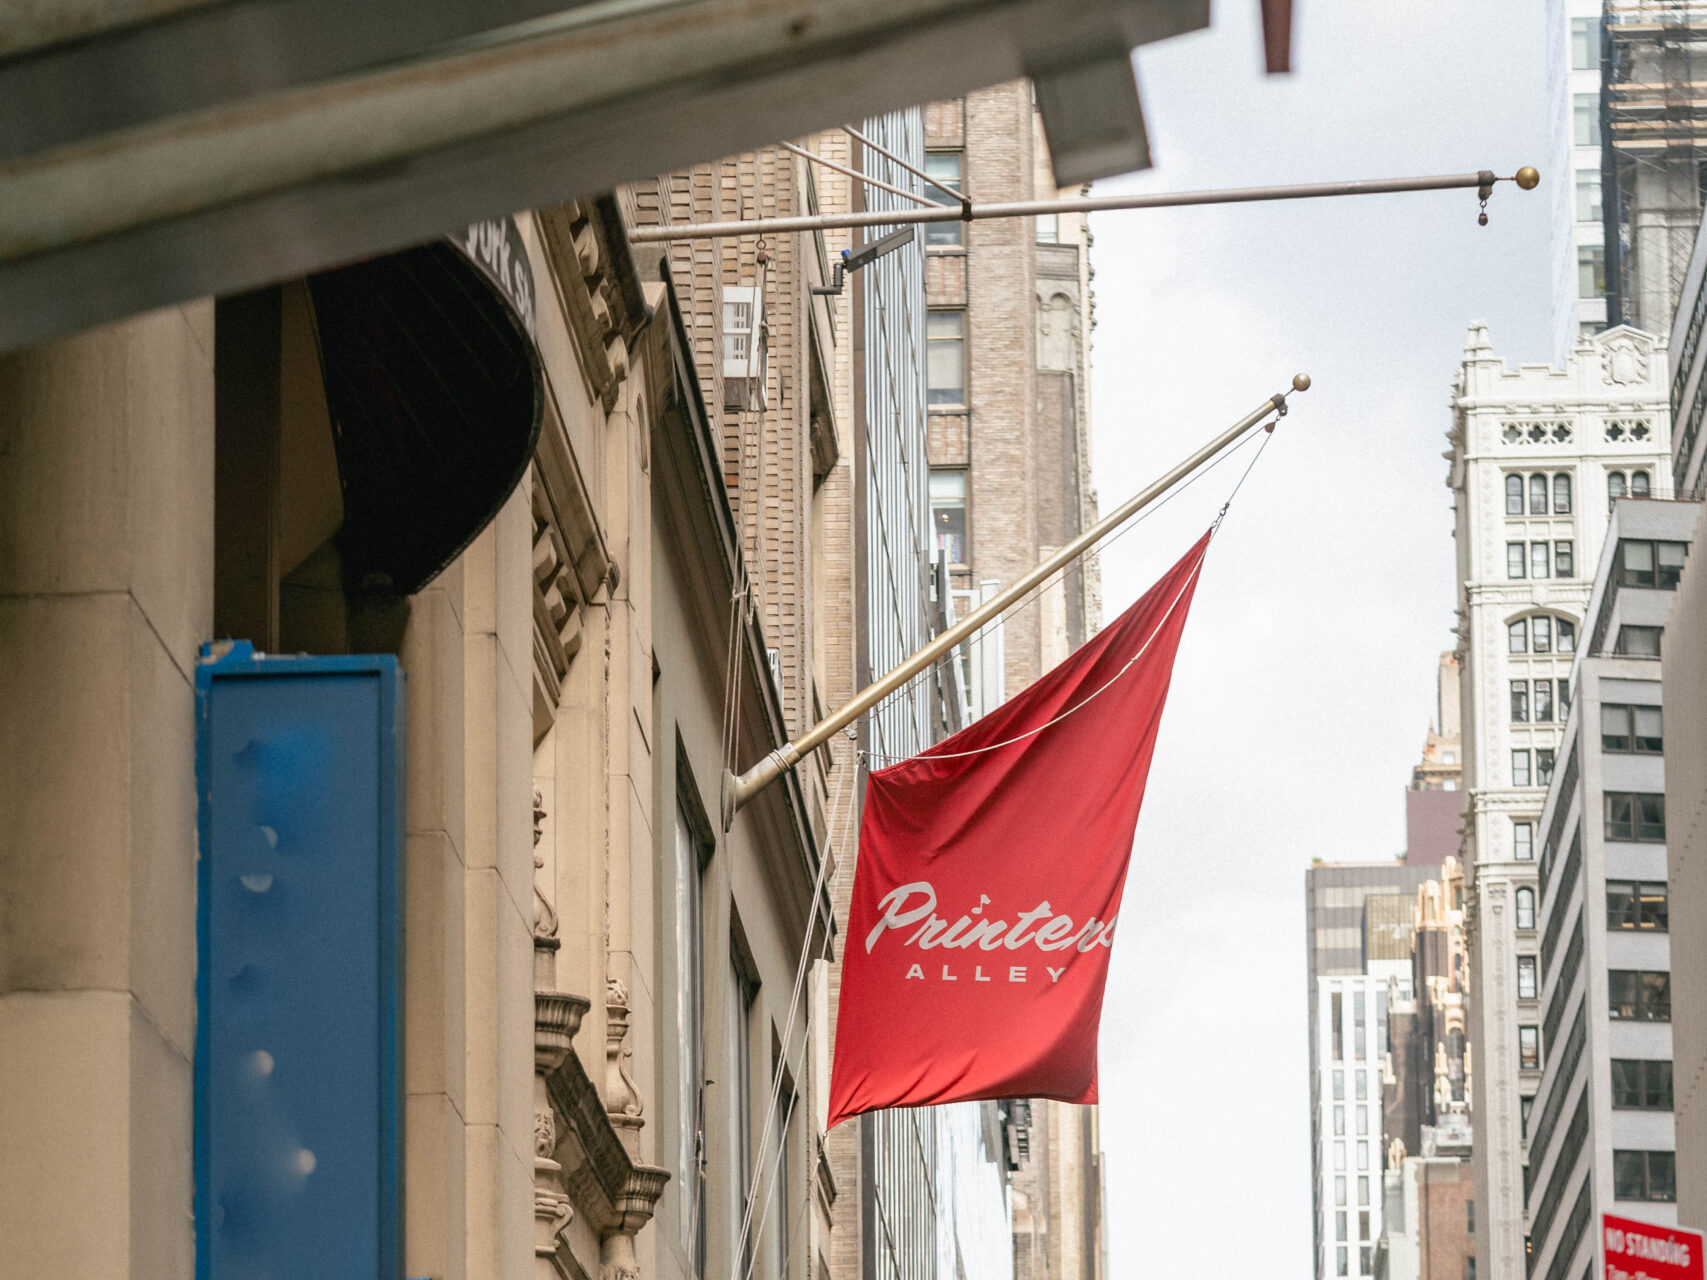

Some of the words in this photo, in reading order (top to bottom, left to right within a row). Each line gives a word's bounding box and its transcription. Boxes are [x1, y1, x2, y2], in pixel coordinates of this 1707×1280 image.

[905, 963, 1066, 983] ALLEY
[1605, 1227, 1625, 1254] NO
[1625, 1232, 1691, 1268] STANDING
